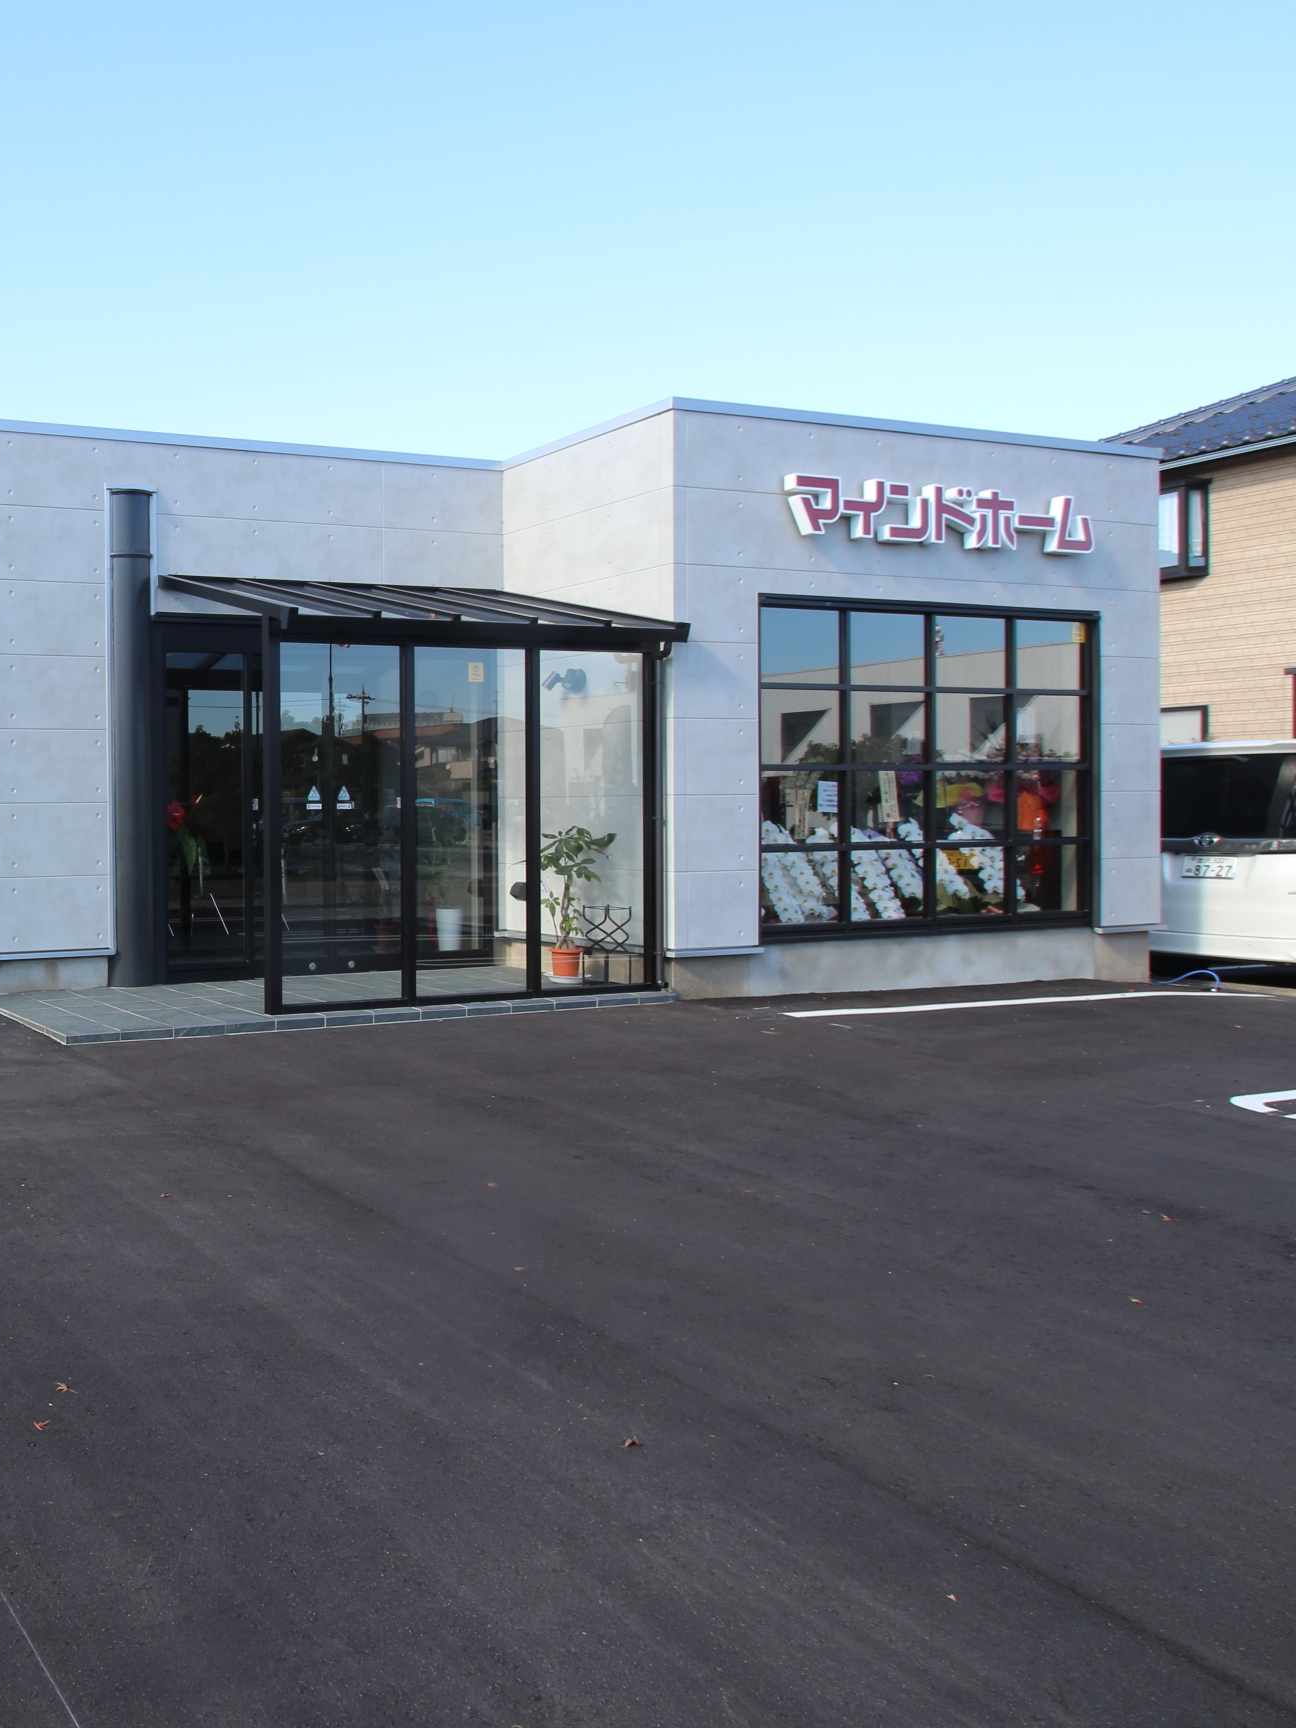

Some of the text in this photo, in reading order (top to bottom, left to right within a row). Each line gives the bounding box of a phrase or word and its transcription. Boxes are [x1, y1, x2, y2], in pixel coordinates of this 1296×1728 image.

[784, 473, 1094, 554] マインドホーム
[1193, 864, 1233, 877] 87-27
